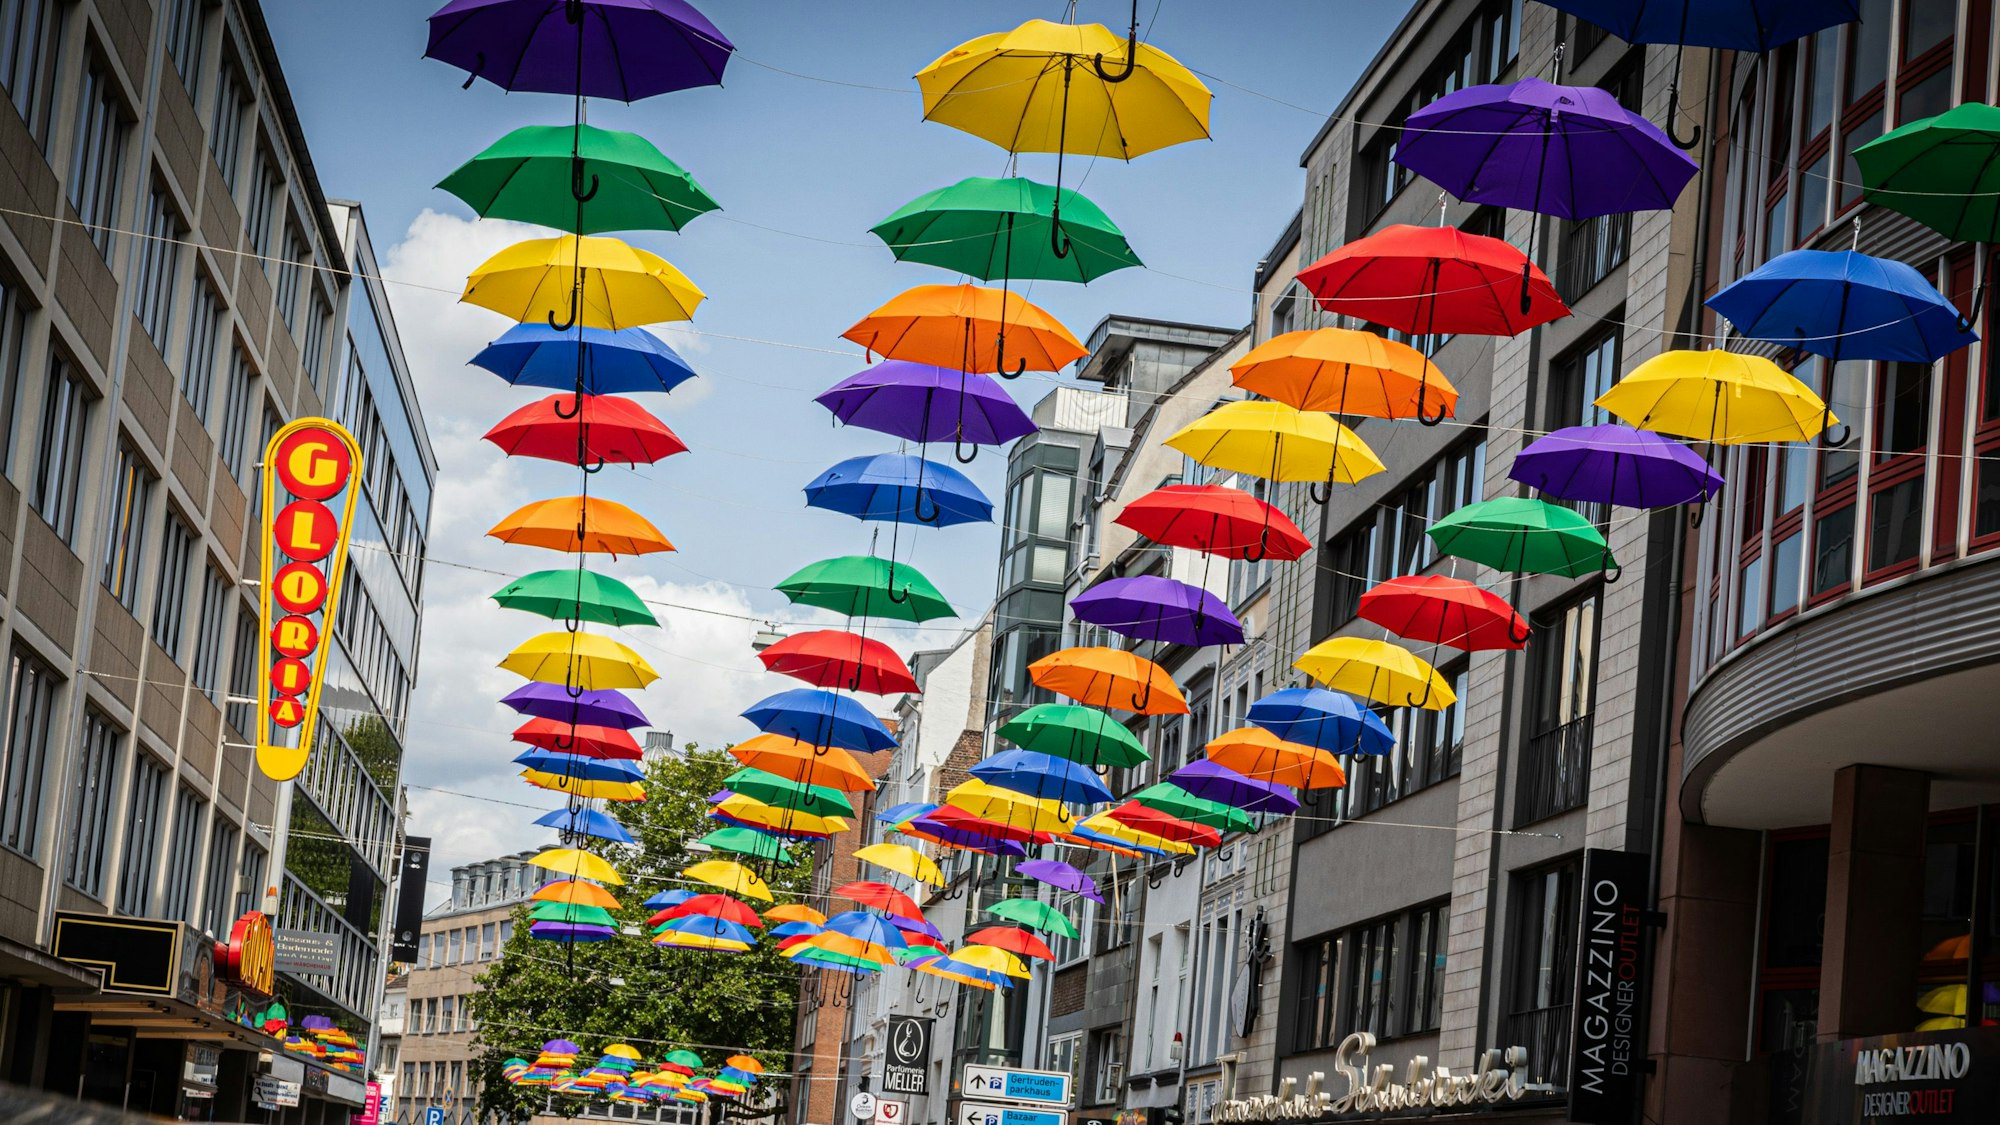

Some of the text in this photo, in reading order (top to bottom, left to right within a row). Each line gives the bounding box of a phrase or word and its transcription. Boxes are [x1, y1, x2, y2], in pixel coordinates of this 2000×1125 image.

[276, 442, 338, 722] GLORIA
[277, 935, 333, 947] Dessous &
[276, 943, 334, 955] Bademode
[1581, 880, 1619, 1094] MAGAZZINO
[1855, 1042, 1970, 1085] MAGAZZINO
[886, 1064, 925, 1076] Parfümerie
[884, 1072, 924, 1092] MELLER
[1011, 1074, 1060, 1087] Gertruden-
[1009, 1085, 1051, 1097] parkhaus
[1006, 1111, 1038, 1121] Bazaar
